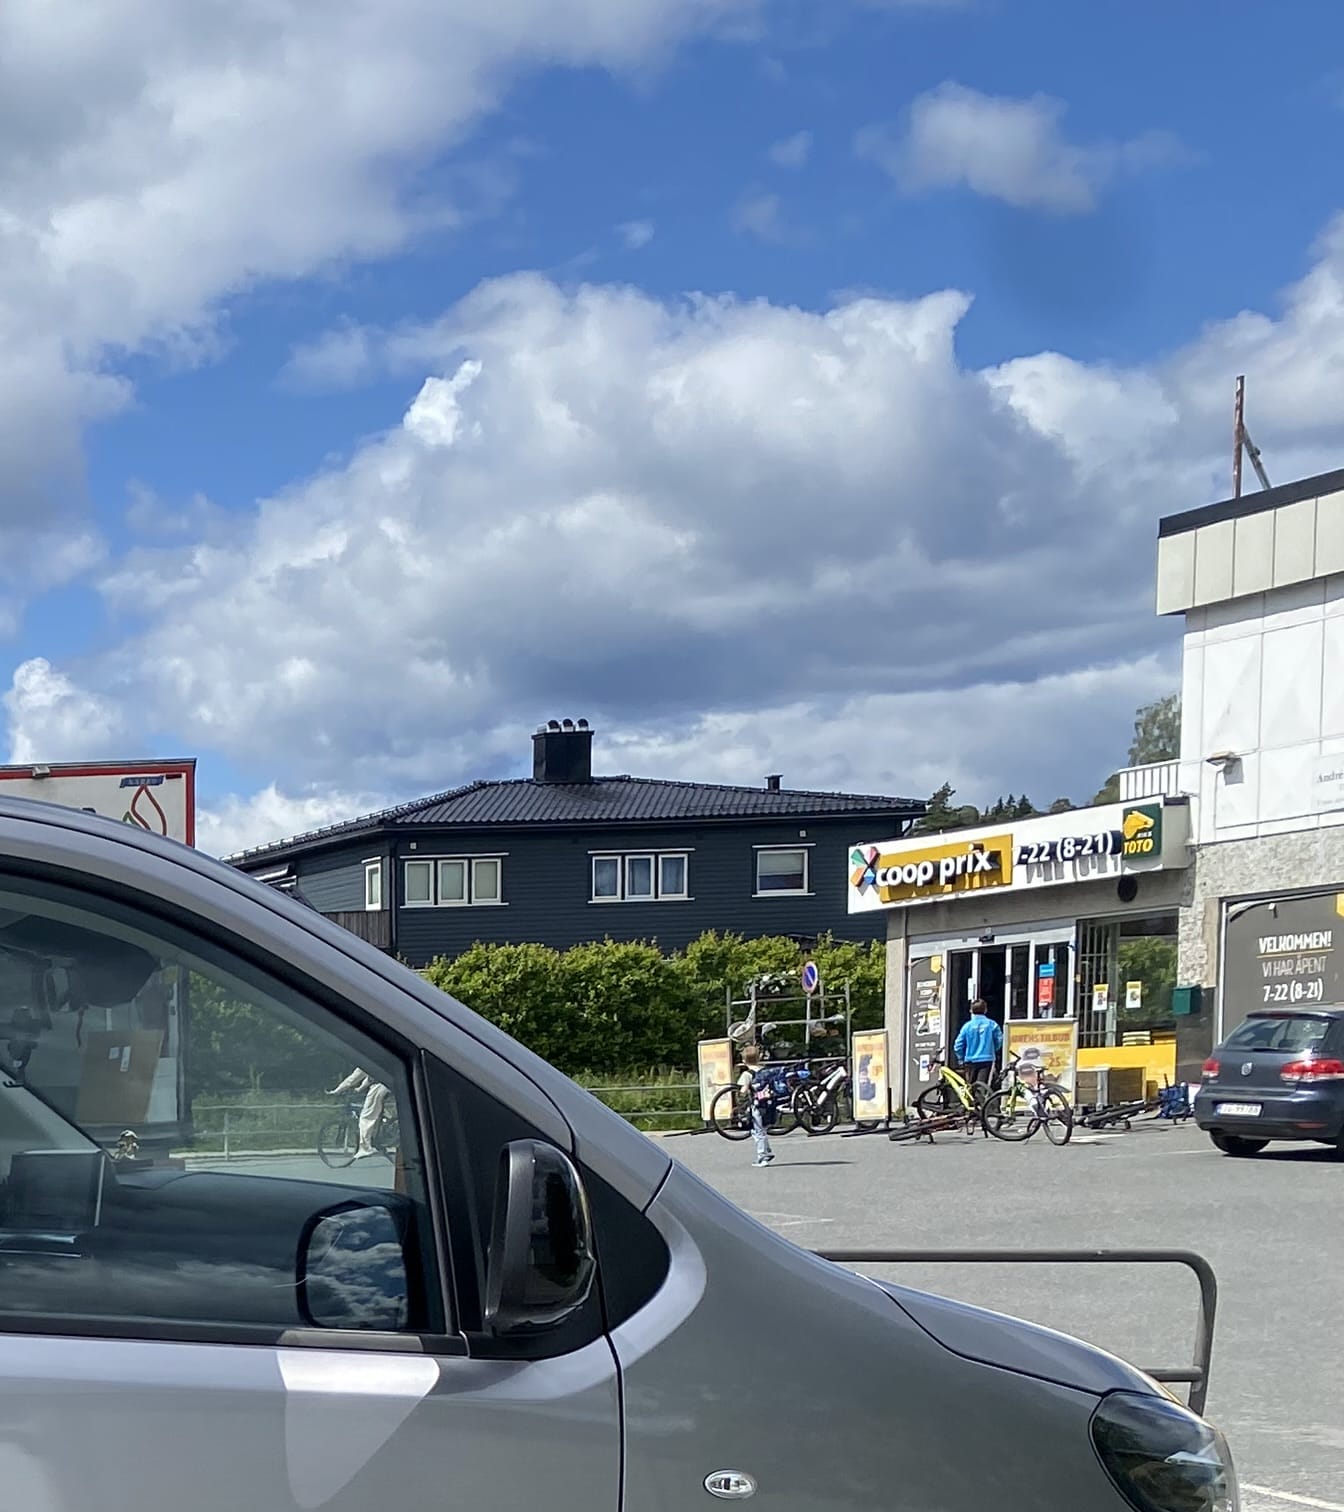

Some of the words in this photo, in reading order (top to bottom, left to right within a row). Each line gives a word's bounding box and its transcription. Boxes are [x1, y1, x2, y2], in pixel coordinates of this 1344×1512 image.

[1056, 831, 1112, 862] (8-21)
[1123, 838, 1154, 855] TOTO
[876, 860, 934, 887] coop
[939, 842, 992, 886] prix
[1258, 930, 1333, 954] VELKOMMEN!
[1262, 962, 1272, 978] VI
[1273, 959, 1294, 977] HAR
[1295, 954, 1328, 975] ÅPENT
[1263, 983, 1288, 1002] 7-22
[1289, 977, 1324, 1003] (8-21)
